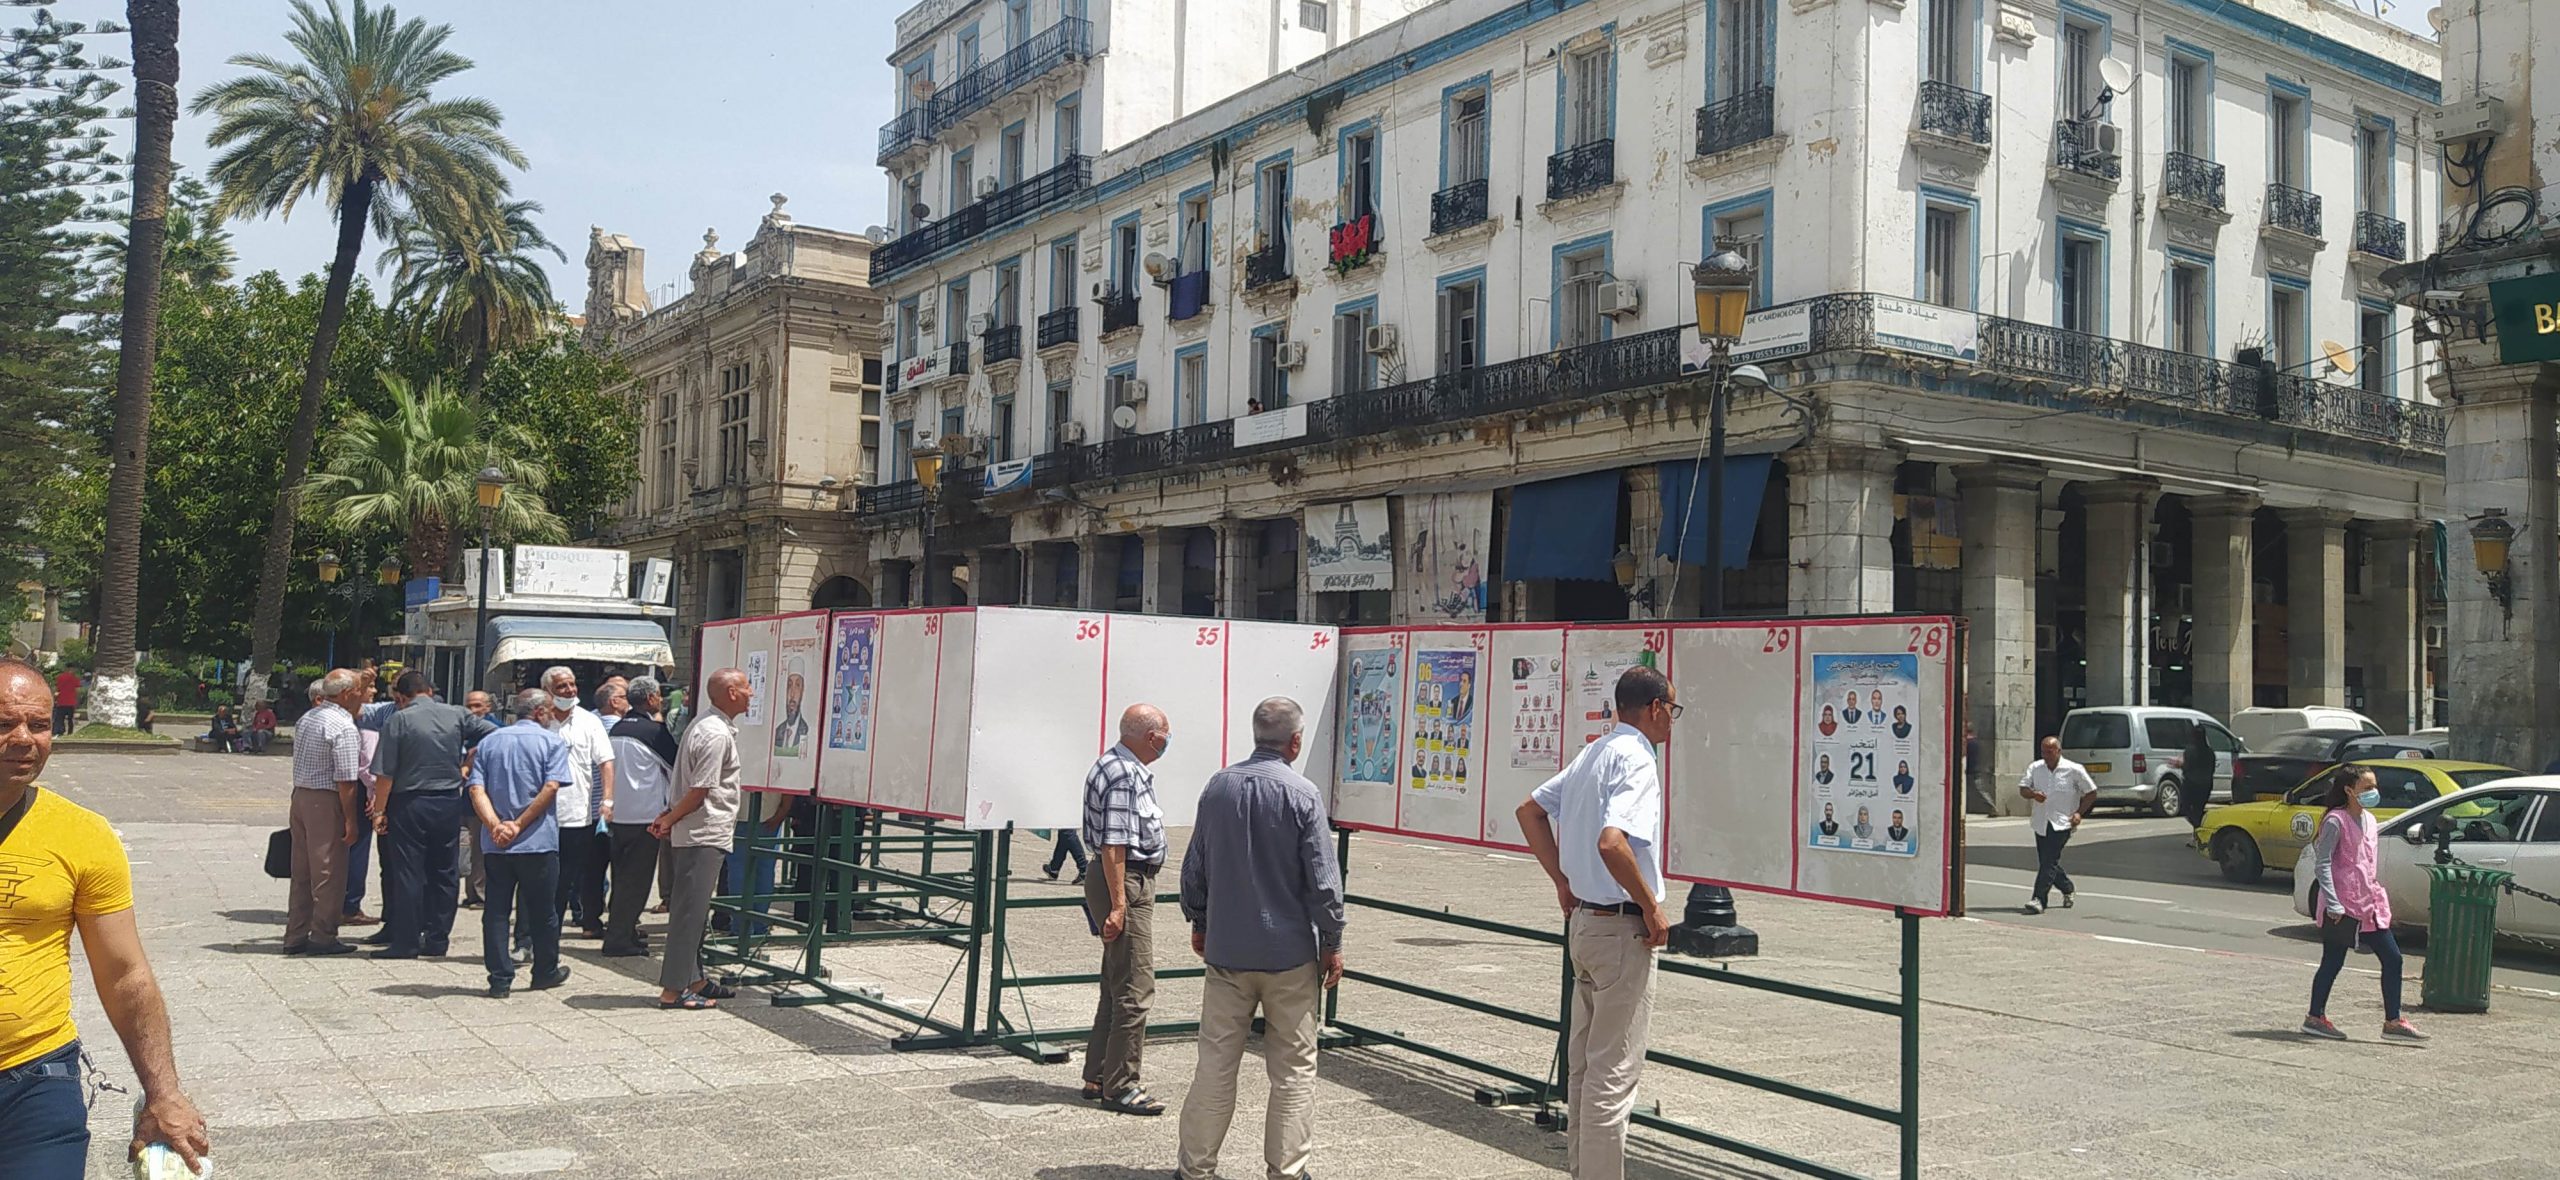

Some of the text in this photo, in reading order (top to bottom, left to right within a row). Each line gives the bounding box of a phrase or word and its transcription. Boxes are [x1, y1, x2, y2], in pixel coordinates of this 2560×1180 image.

[1758, 306, 1806, 322] CARDIOLOGIE
[1877, 299, 1938, 321] عيادة طبية
[924, 615, 938, 636] 38
[1076, 619, 1101, 641] 36
[1195, 626, 1221, 646] 35
[1310, 631, 1331, 650] 34
[1471, 632, 1486, 651] 32
[1643, 629, 1665, 653] 30
[1763, 628, 1790, 653] 29
[1907, 625, 1942, 657] 28
[1418, 662, 1433, 682] 06
[1850, 751, 1877, 782] 21
